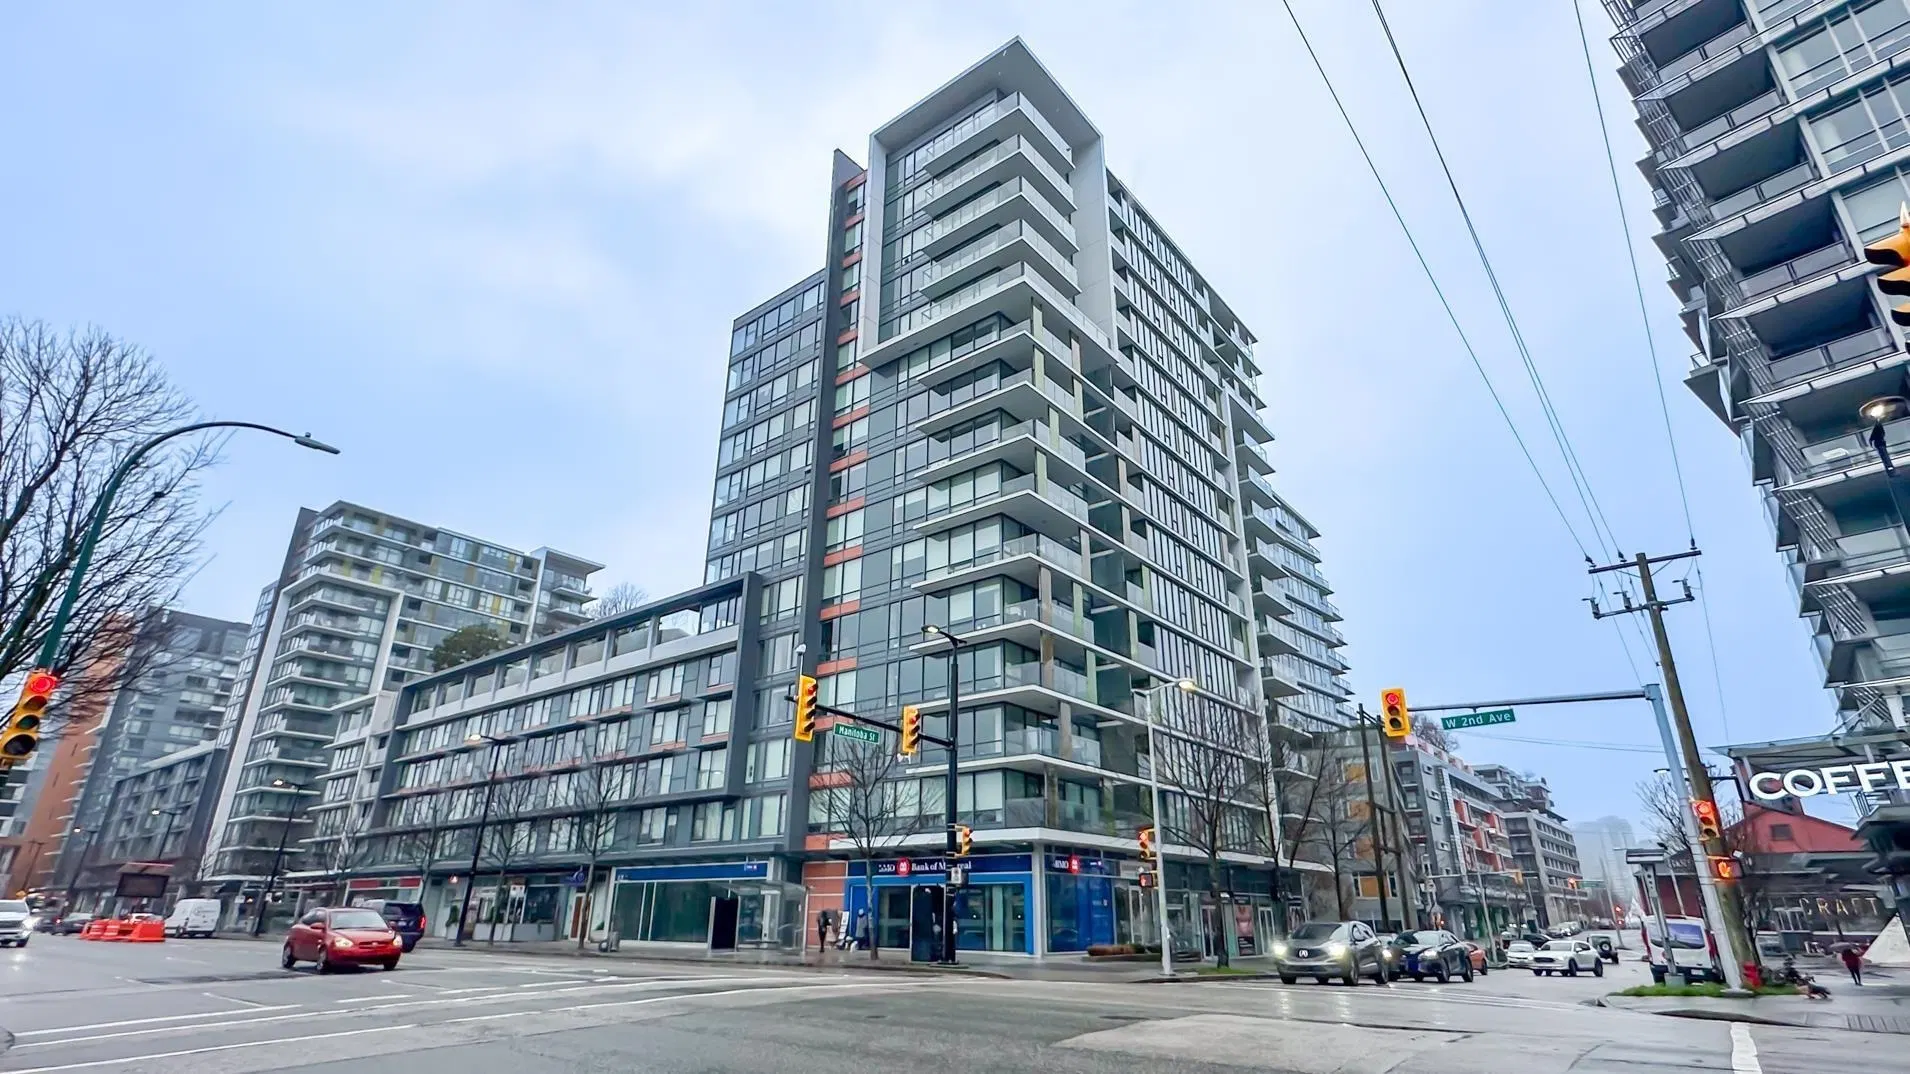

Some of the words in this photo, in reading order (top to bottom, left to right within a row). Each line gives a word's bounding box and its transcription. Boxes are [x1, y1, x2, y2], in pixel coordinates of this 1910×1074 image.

[1445, 718, 1456, 728] W
[1462, 715, 1483, 727] 2nd
[1489, 712, 1511, 723] Ave
[838, 725, 868, 740] Manitoba
[869, 732, 876, 741] St
[911, 862, 930, 871] Bank
[930, 861, 938, 871] of
